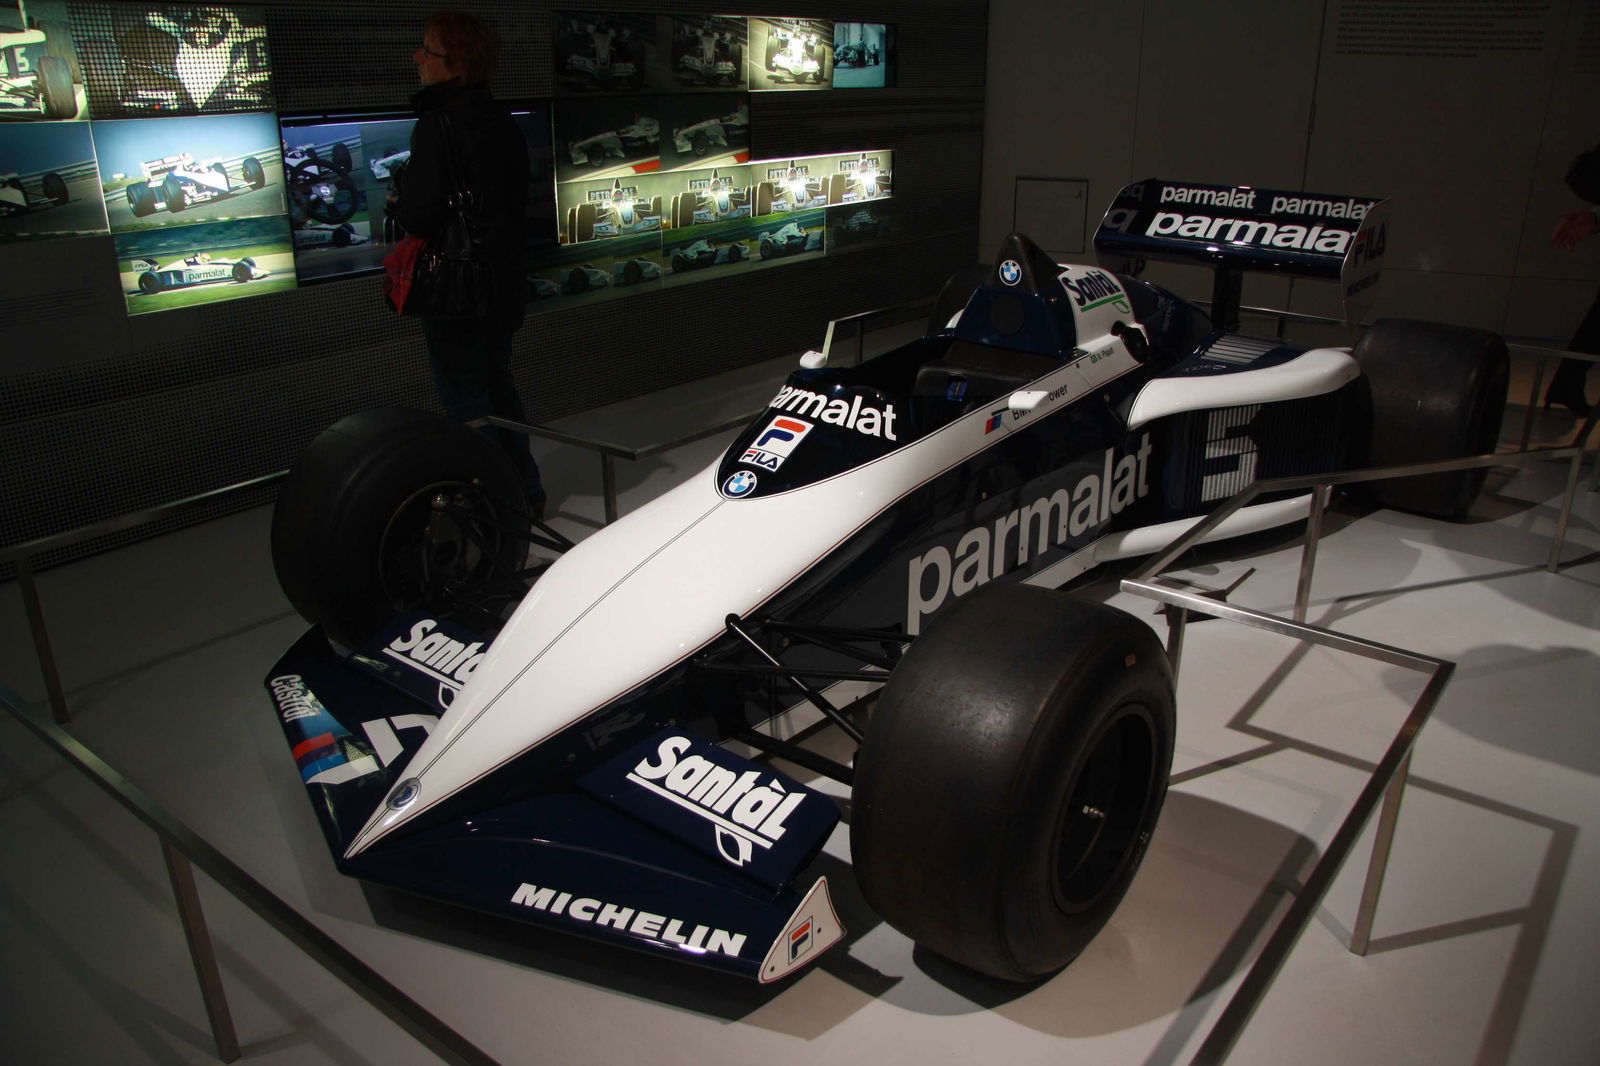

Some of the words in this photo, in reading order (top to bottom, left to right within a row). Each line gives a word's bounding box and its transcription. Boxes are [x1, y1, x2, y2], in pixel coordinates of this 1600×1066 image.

[1160, 186, 1256, 209] parmalat
[1145, 211, 1357, 254] parmala
[189, 269, 226, 282] parmalat
[769, 385, 897, 442] armalat
[1012, 408, 1031, 421] BM
[1048, 384, 1068, 402] ower
[741, 449, 779, 470] FILA
[1201, 404, 1262, 503] 5
[907, 432, 1152, 636] parmalat
[510, 882, 748, 957] MICHELIN
